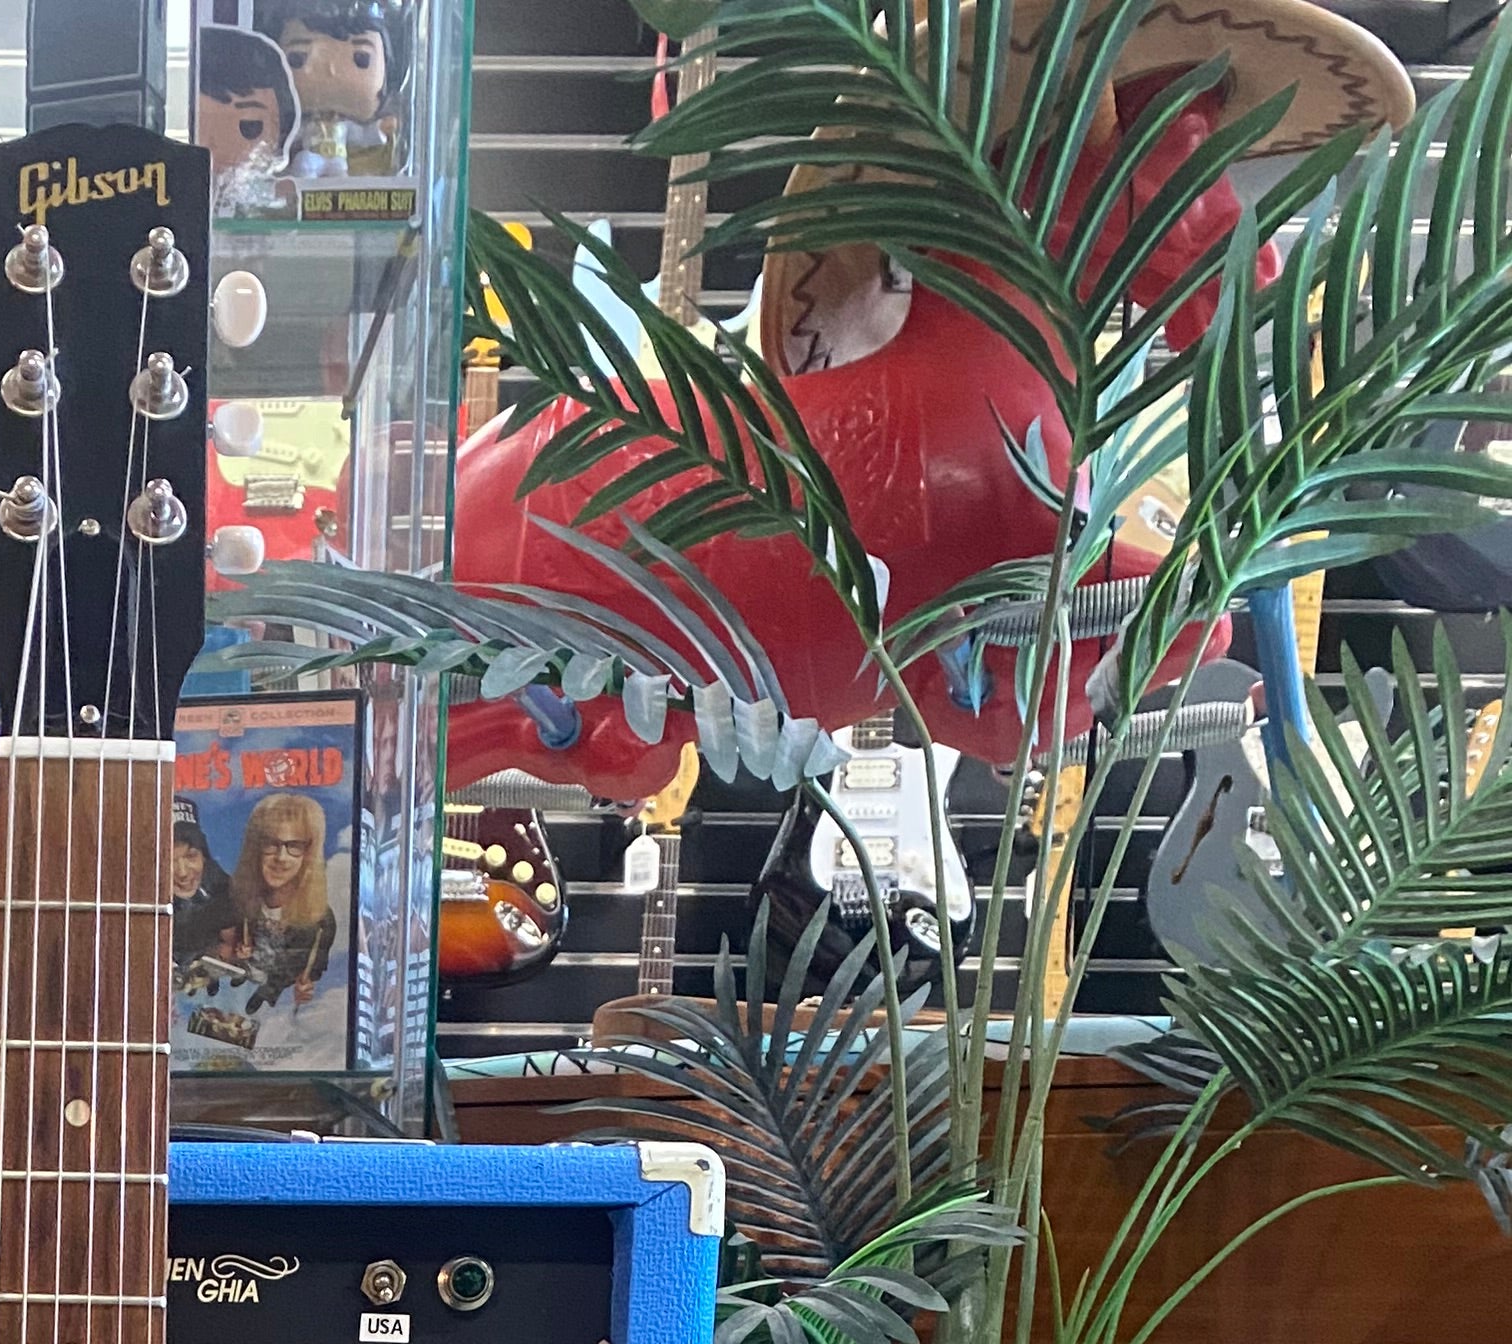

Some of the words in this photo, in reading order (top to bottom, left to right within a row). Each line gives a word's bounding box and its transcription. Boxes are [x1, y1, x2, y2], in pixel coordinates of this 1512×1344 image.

[19, 157, 170, 225] Gibson
[304, 191, 333, 212] ELVIS
[338, 190, 388, 211] PHARAOH
[390, 189, 414, 211] SUIT
[250, 707, 335, 720] COLLECTION
[240, 747, 344, 789] WORLD
[197, 1279, 259, 1303] GHIA
[367, 1317, 403, 1336] USA
